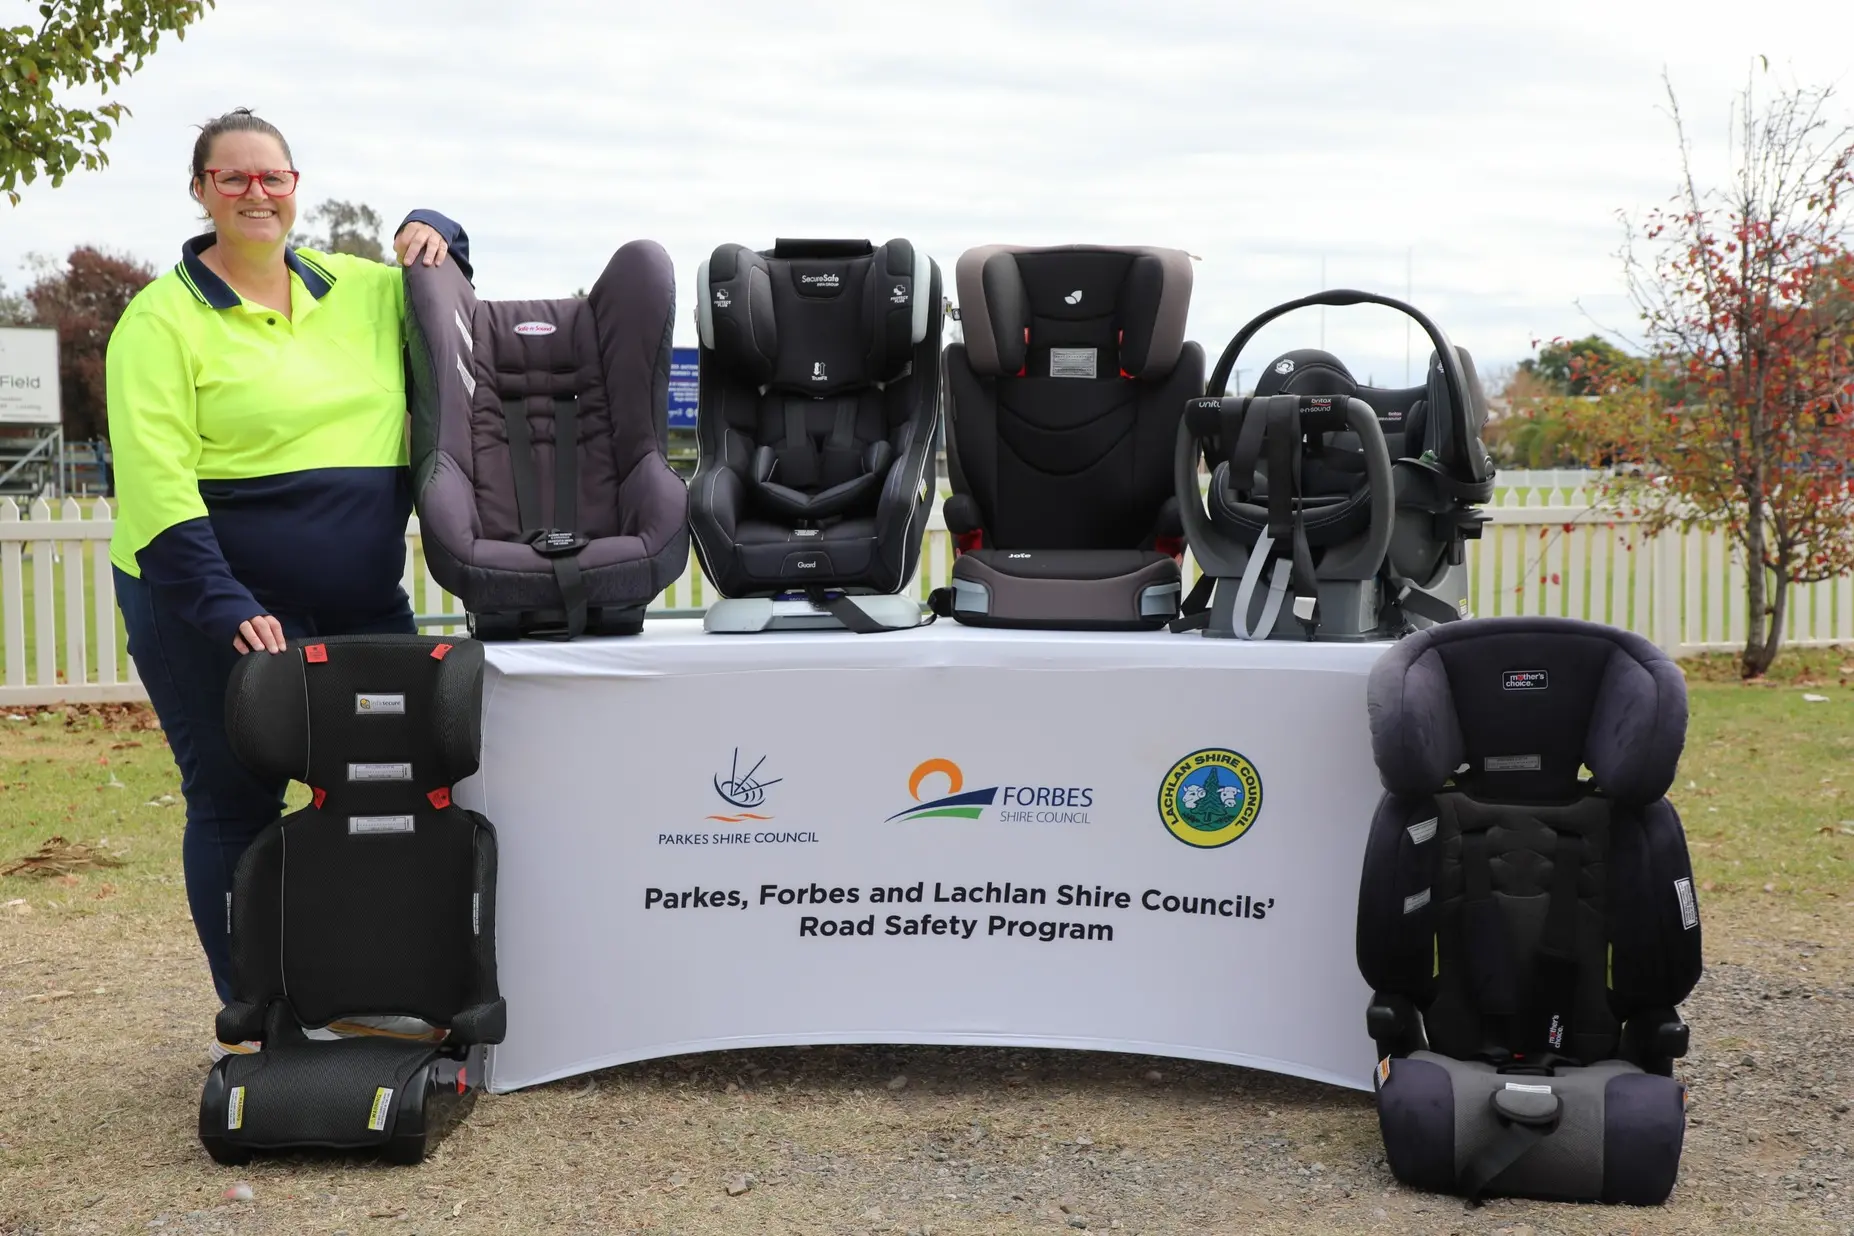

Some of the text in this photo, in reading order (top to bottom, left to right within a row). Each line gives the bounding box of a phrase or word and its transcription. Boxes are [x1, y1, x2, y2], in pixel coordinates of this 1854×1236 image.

[801, 273, 839, 283] SecureSafe
[0, 375, 40, 389] Field
[797, 561, 817, 569] Guard
[1002, 786, 1094, 808] FORBES
[1164, 753, 1257, 827] LACHLAN SHIRE COUNCIL
[1000, 811, 1091, 824] SHIRE COUNCIL
[658, 832, 819, 845] PARKES SHIRE COUNCIL
[644, 881, 1276, 920] Parkes, Forbes and Lachlan Shire Councils'
[799, 913, 1114, 942] Road Safety Program
